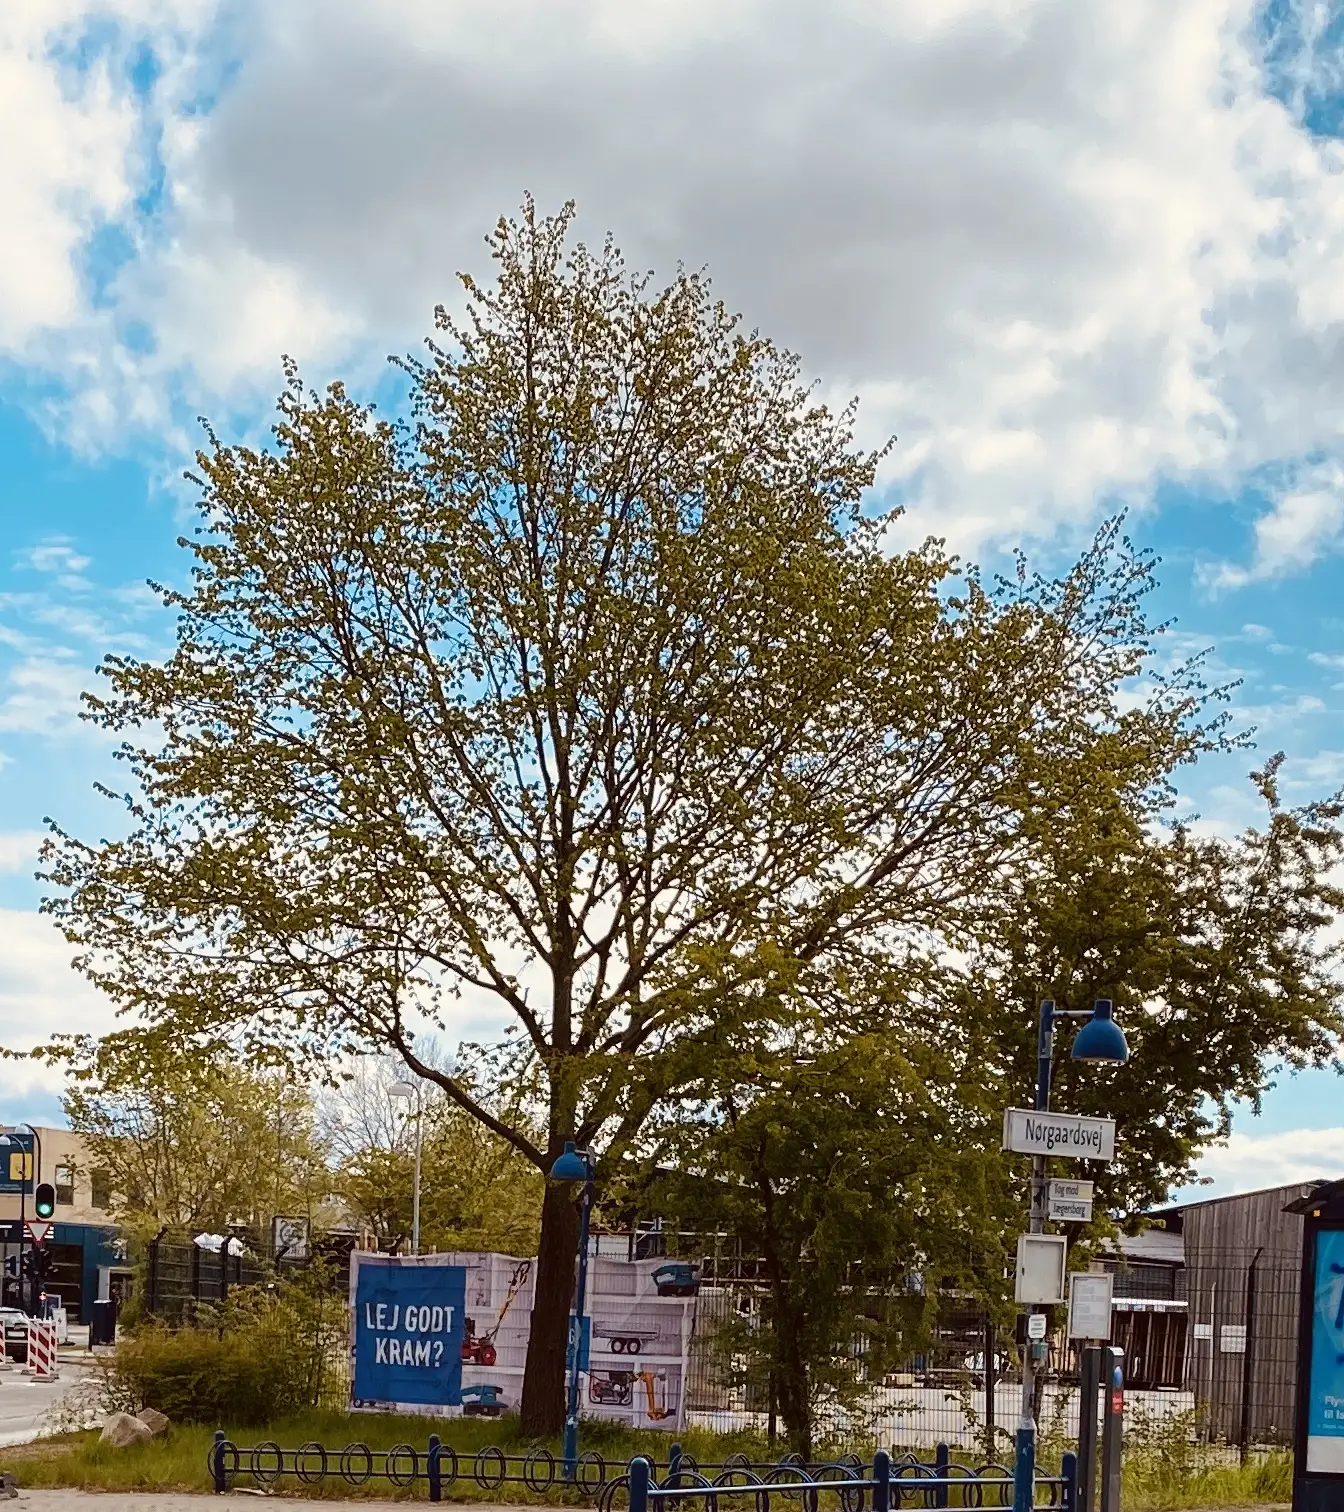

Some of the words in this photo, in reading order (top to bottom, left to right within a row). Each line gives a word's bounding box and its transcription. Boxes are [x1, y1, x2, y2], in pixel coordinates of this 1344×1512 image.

[1025, 1118, 1103, 1154] Nørgaardsvej
[365, 1302, 399, 1331] LEJ
[404, 1305, 455, 1333] GODT
[375, 1337, 444, 1368] KRAM?
